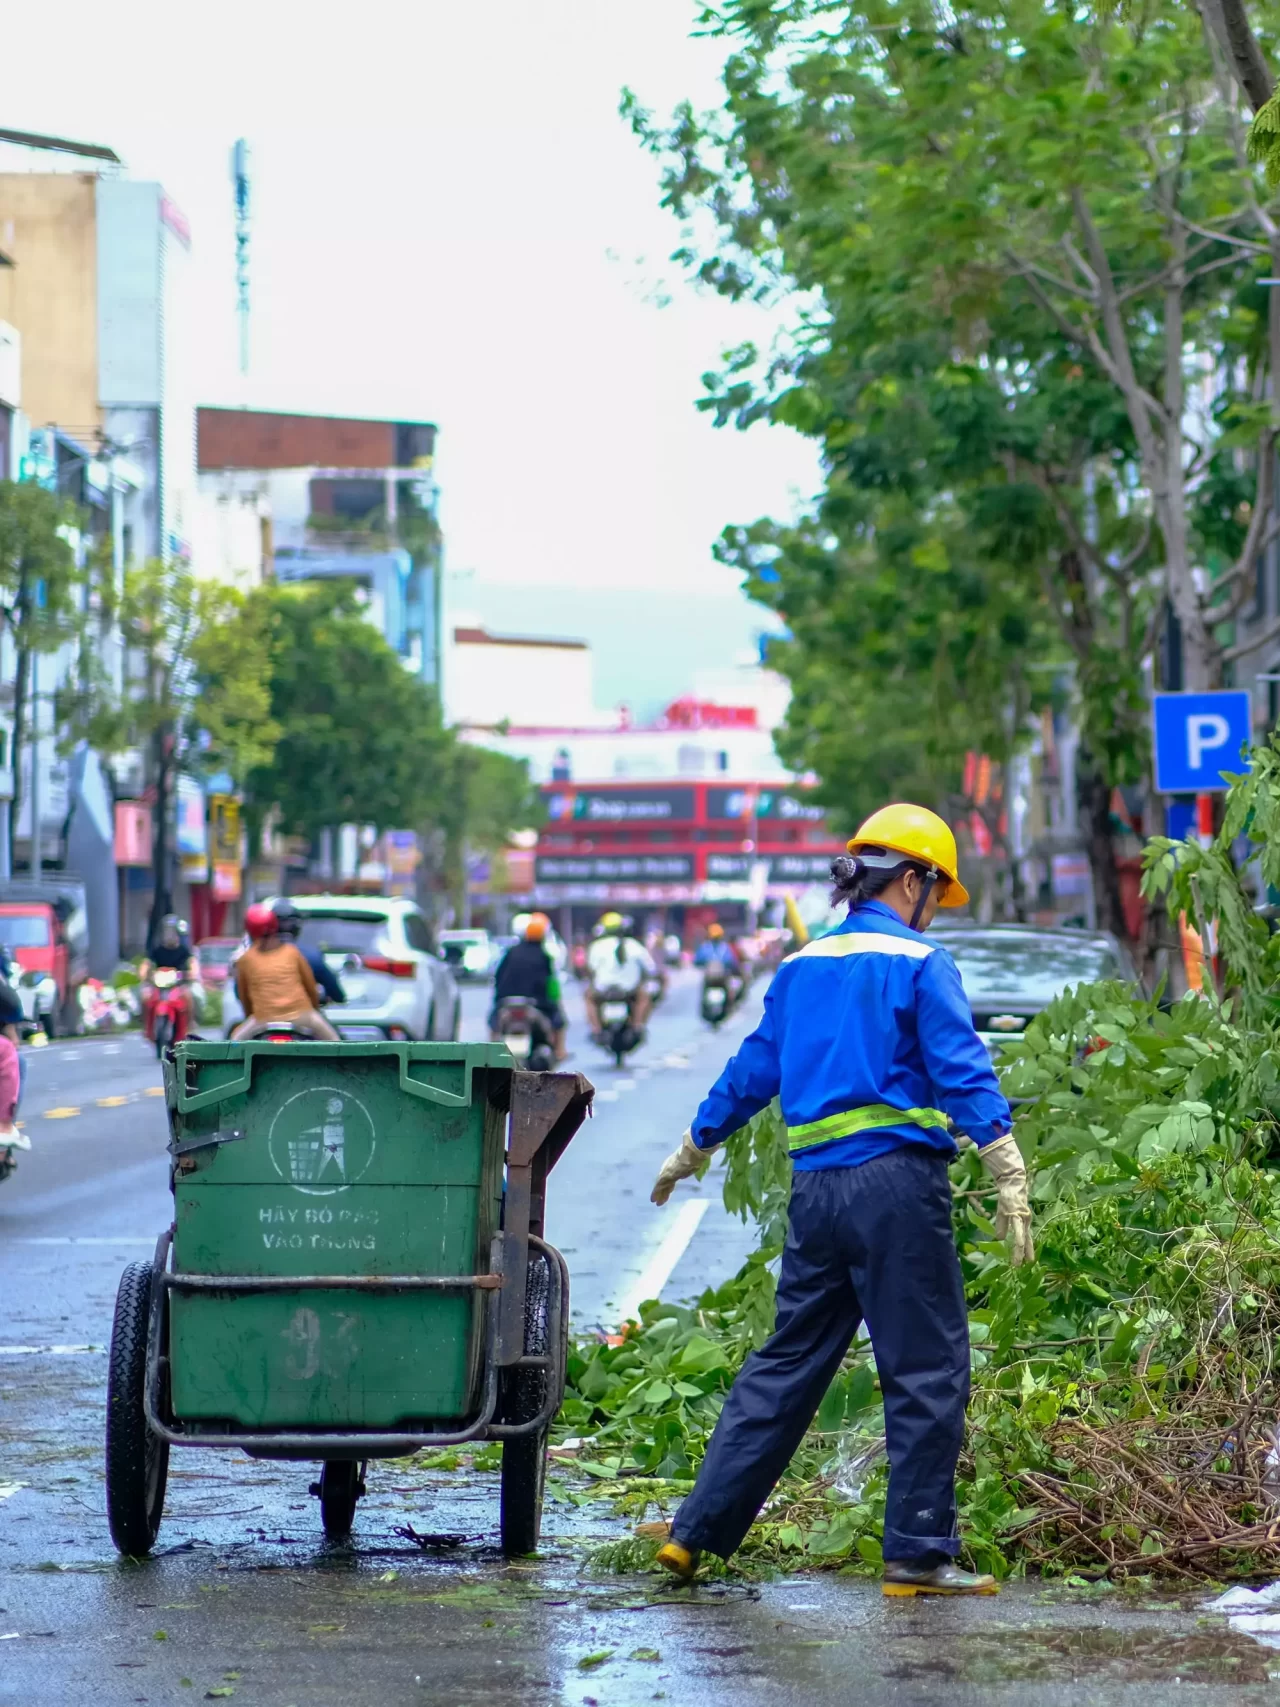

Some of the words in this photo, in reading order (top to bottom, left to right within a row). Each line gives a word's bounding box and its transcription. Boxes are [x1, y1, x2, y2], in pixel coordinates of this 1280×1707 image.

[1187, 714, 1231, 770] P
[259, 1205, 299, 1224] HÃY
[305, 1203, 333, 1224] BỎ
[262, 1231, 302, 1249] VÀO
